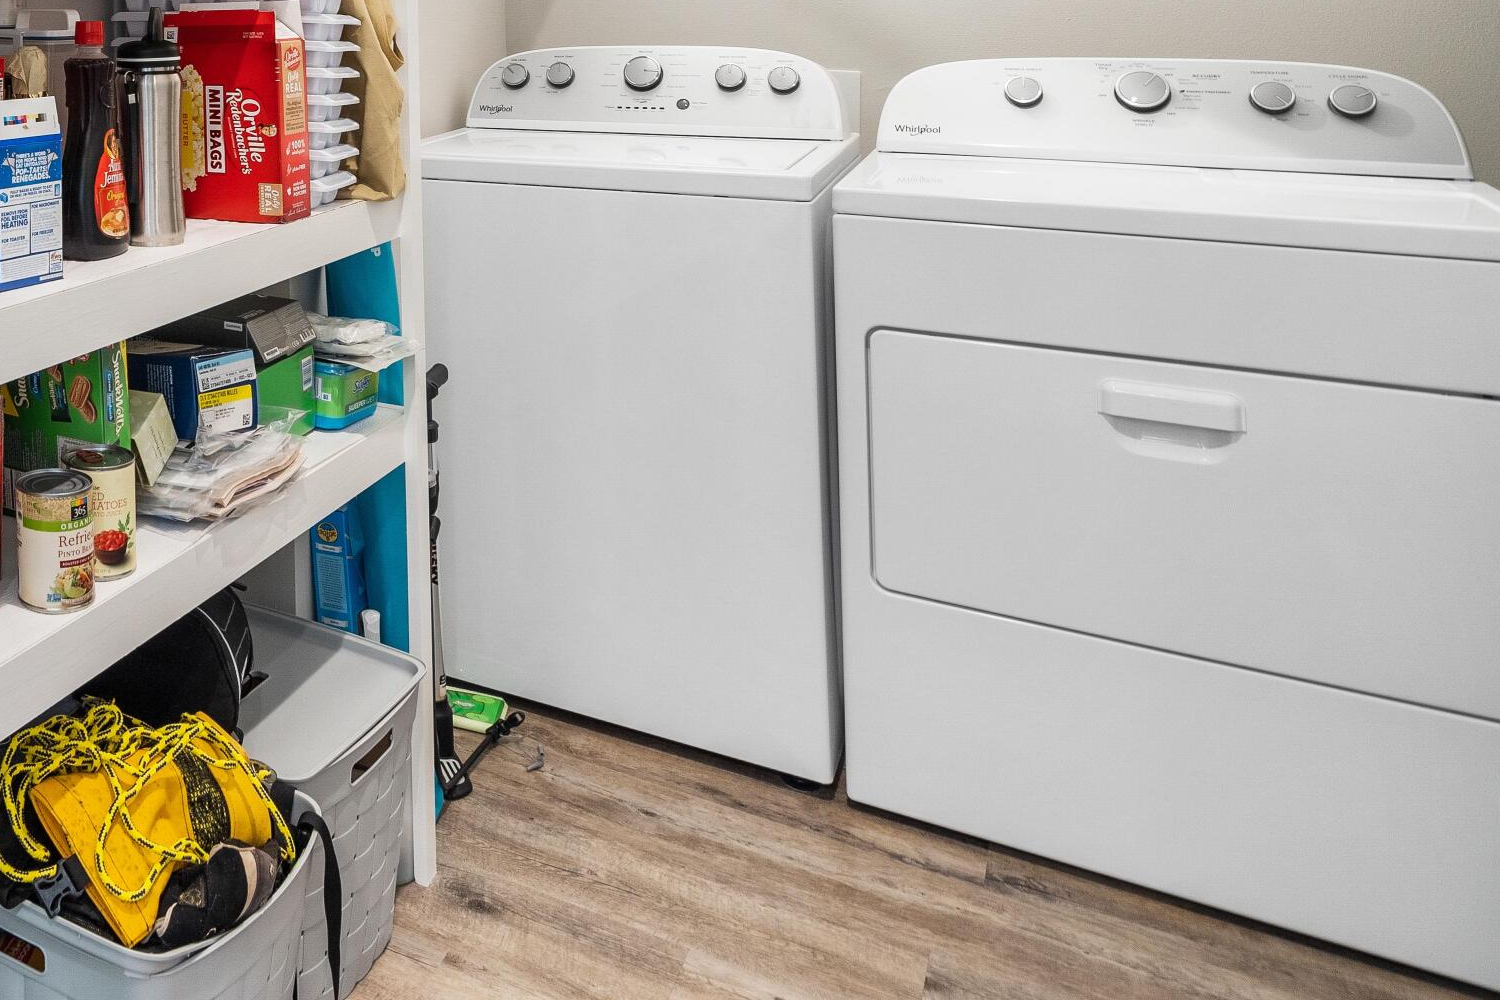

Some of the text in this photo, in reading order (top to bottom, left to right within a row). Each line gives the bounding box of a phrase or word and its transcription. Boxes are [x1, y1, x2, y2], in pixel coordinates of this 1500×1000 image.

[288, 71, 299, 84] Only
[286, 82, 302, 94] REAL
[479, 104, 513, 114] Whirlpool
[208, 89, 222, 170] MINI BAGS
[226, 88, 252, 175] Redenbacher's
[240, 98, 266, 163] Orville
[894, 124, 941, 136] Whirlpool
[292, 141, 306, 150] 100%
[264, 185, 272, 213] REAL
[1, 219, 28, 229] HEATING
[348, 399, 366, 413] SWEEPER
[73, 508, 86, 518] 365
[58, 548, 80, 558] PINTO
